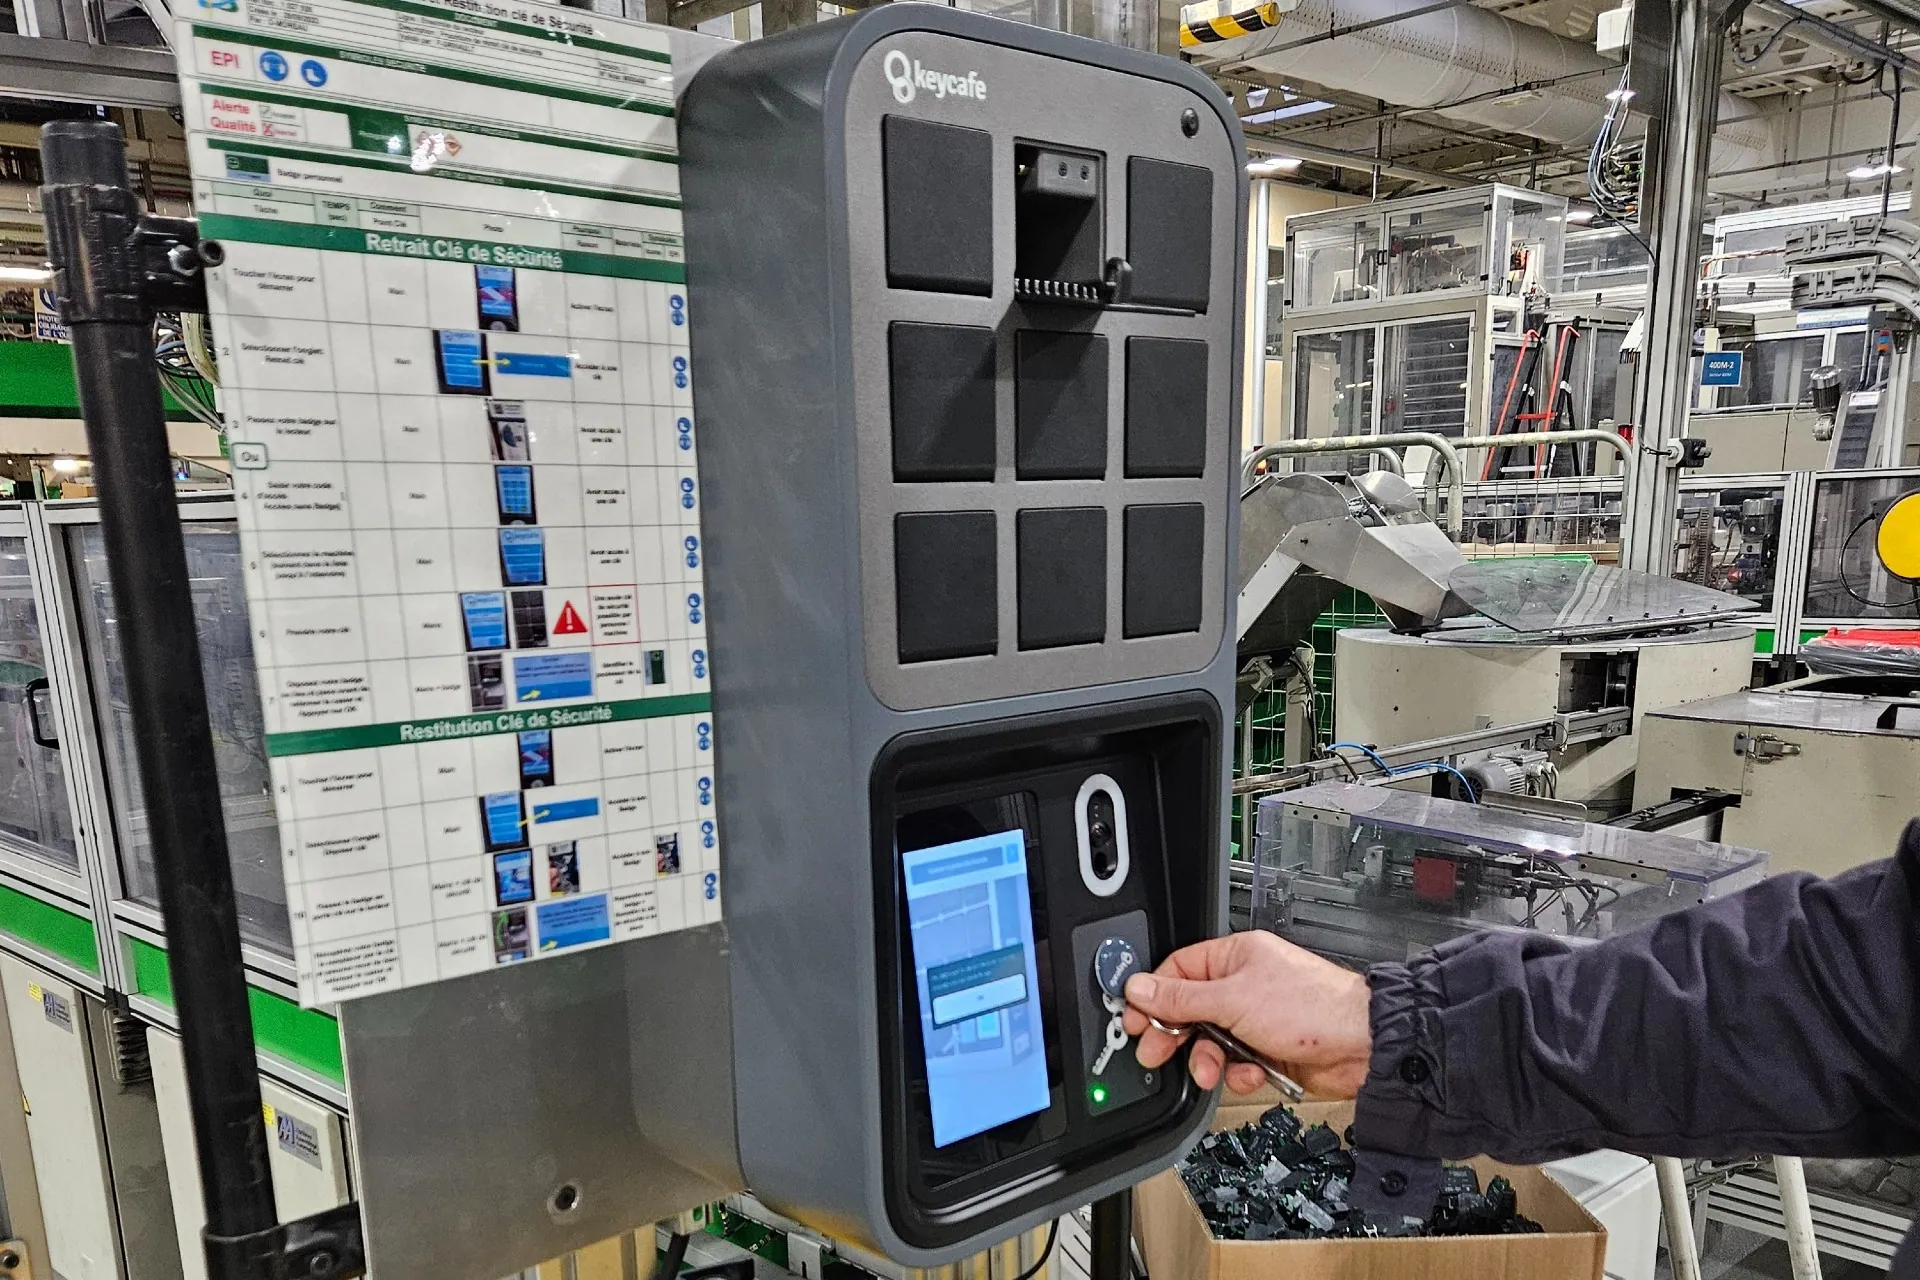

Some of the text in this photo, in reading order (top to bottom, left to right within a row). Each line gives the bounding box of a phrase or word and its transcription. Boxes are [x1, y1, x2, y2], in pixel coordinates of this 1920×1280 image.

[444, 0, 508, 18] Restittion
[531, 13, 545, 26] de
[209, 50, 240, 69] EPI
[913, 59, 988, 100] keycafe
[212, 98, 251, 115] Alerte
[210, 116, 257, 133] Qualité
[321, 200, 351, 211] TEMPS
[370, 201, 407, 213] Comment
[365, 232, 564, 271] Retrait Clé de Sécurité
[1708, 360, 1735, 370] 400M-2
[400, 704, 613, 743] Restitution Clé de Sécurité
